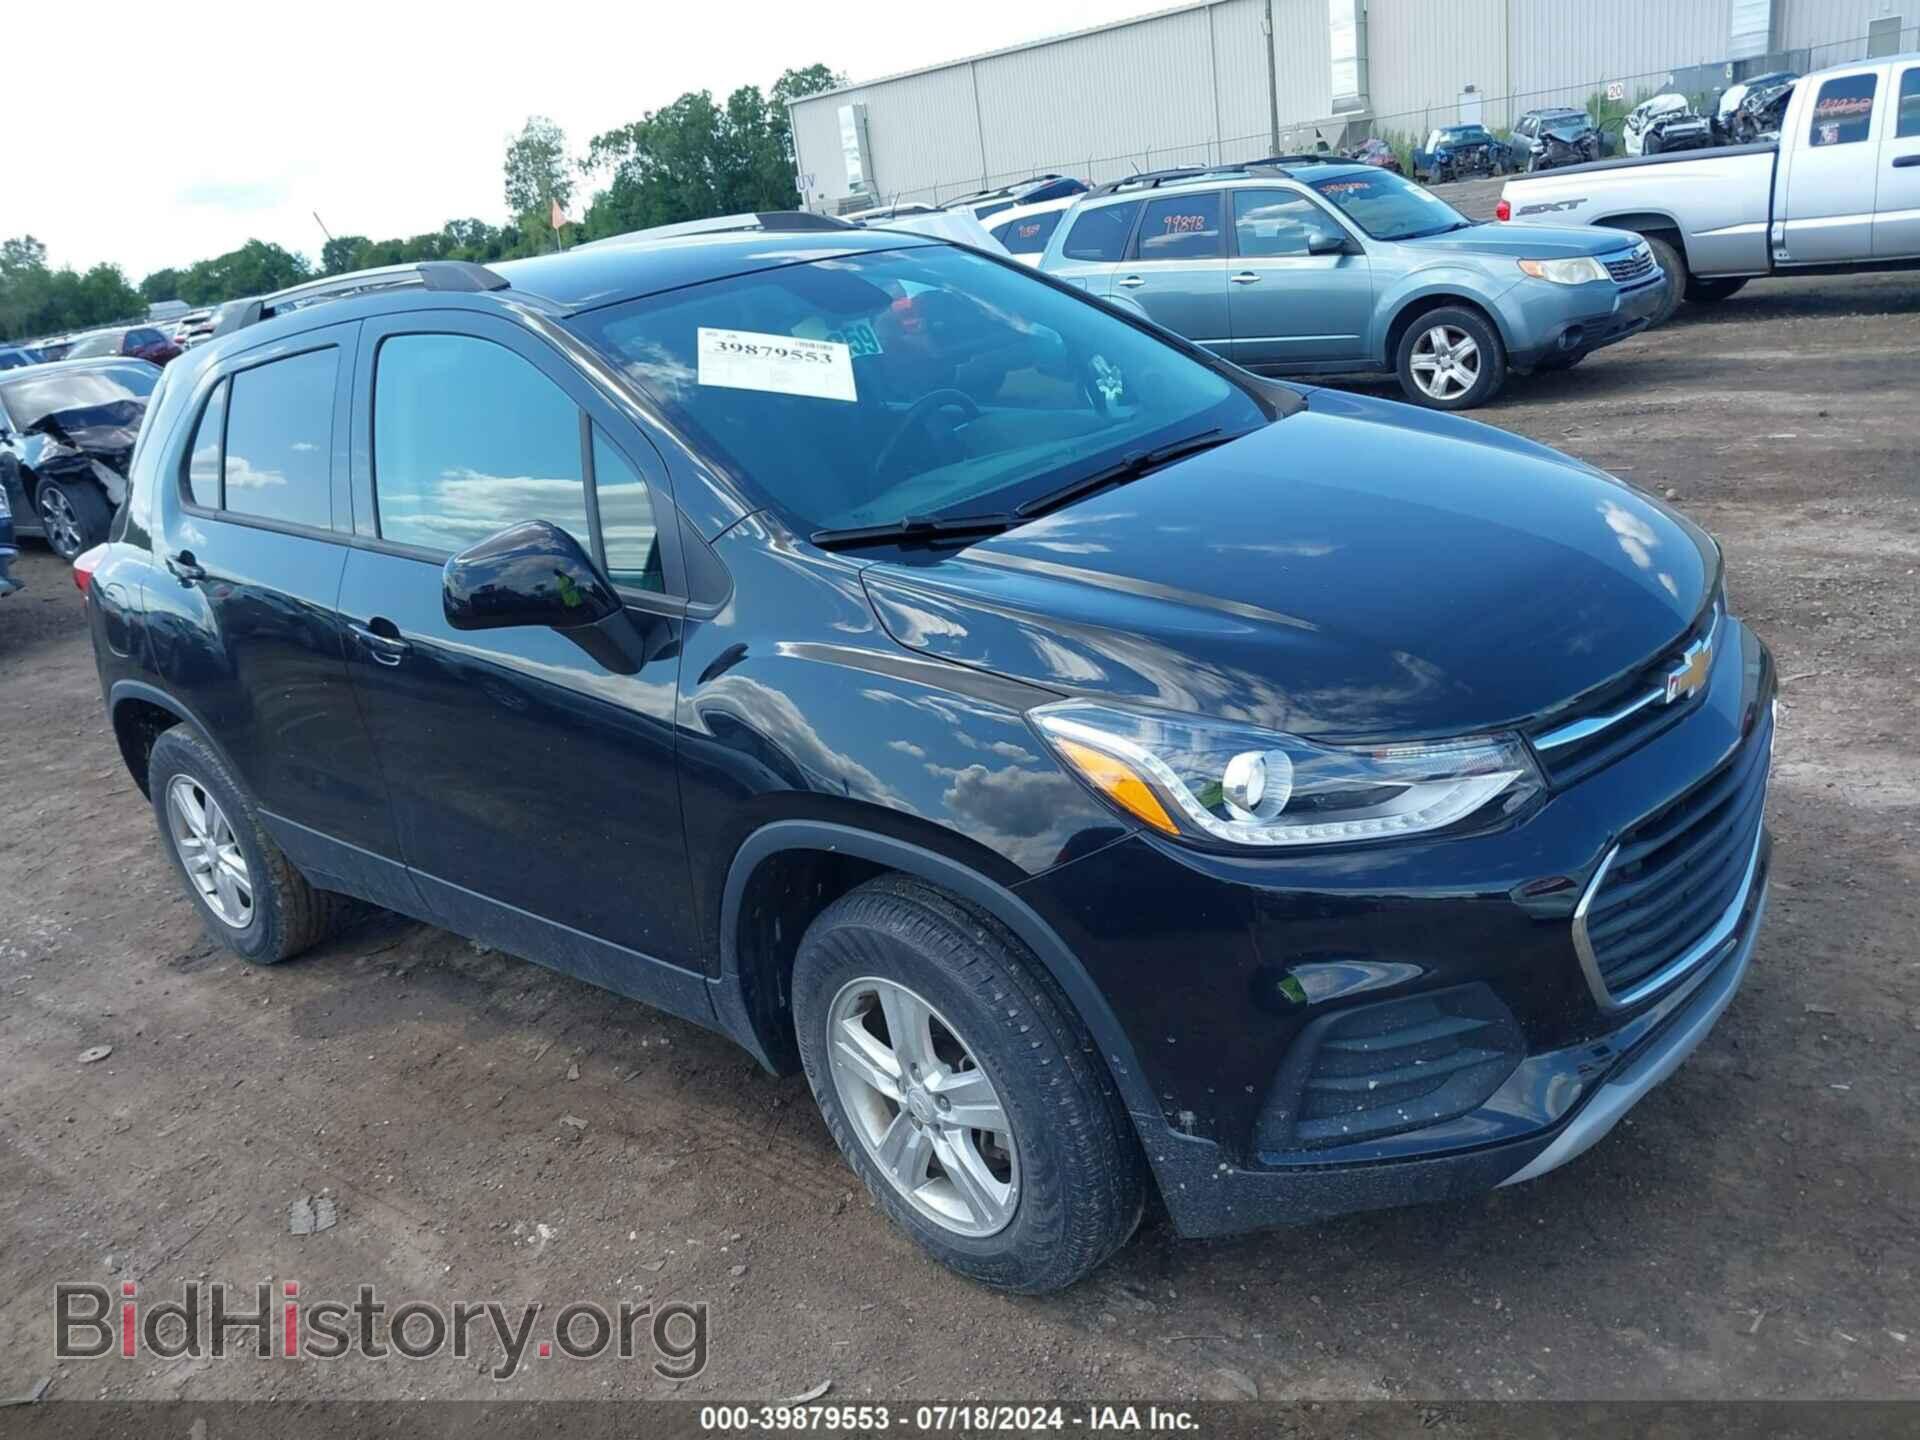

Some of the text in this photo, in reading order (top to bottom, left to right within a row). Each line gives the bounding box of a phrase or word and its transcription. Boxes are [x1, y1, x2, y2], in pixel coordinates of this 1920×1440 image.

[1609, 83, 1623, 98] 20
[1516, 198, 1587, 216] SXT
[713, 340, 833, 364] 39879553
